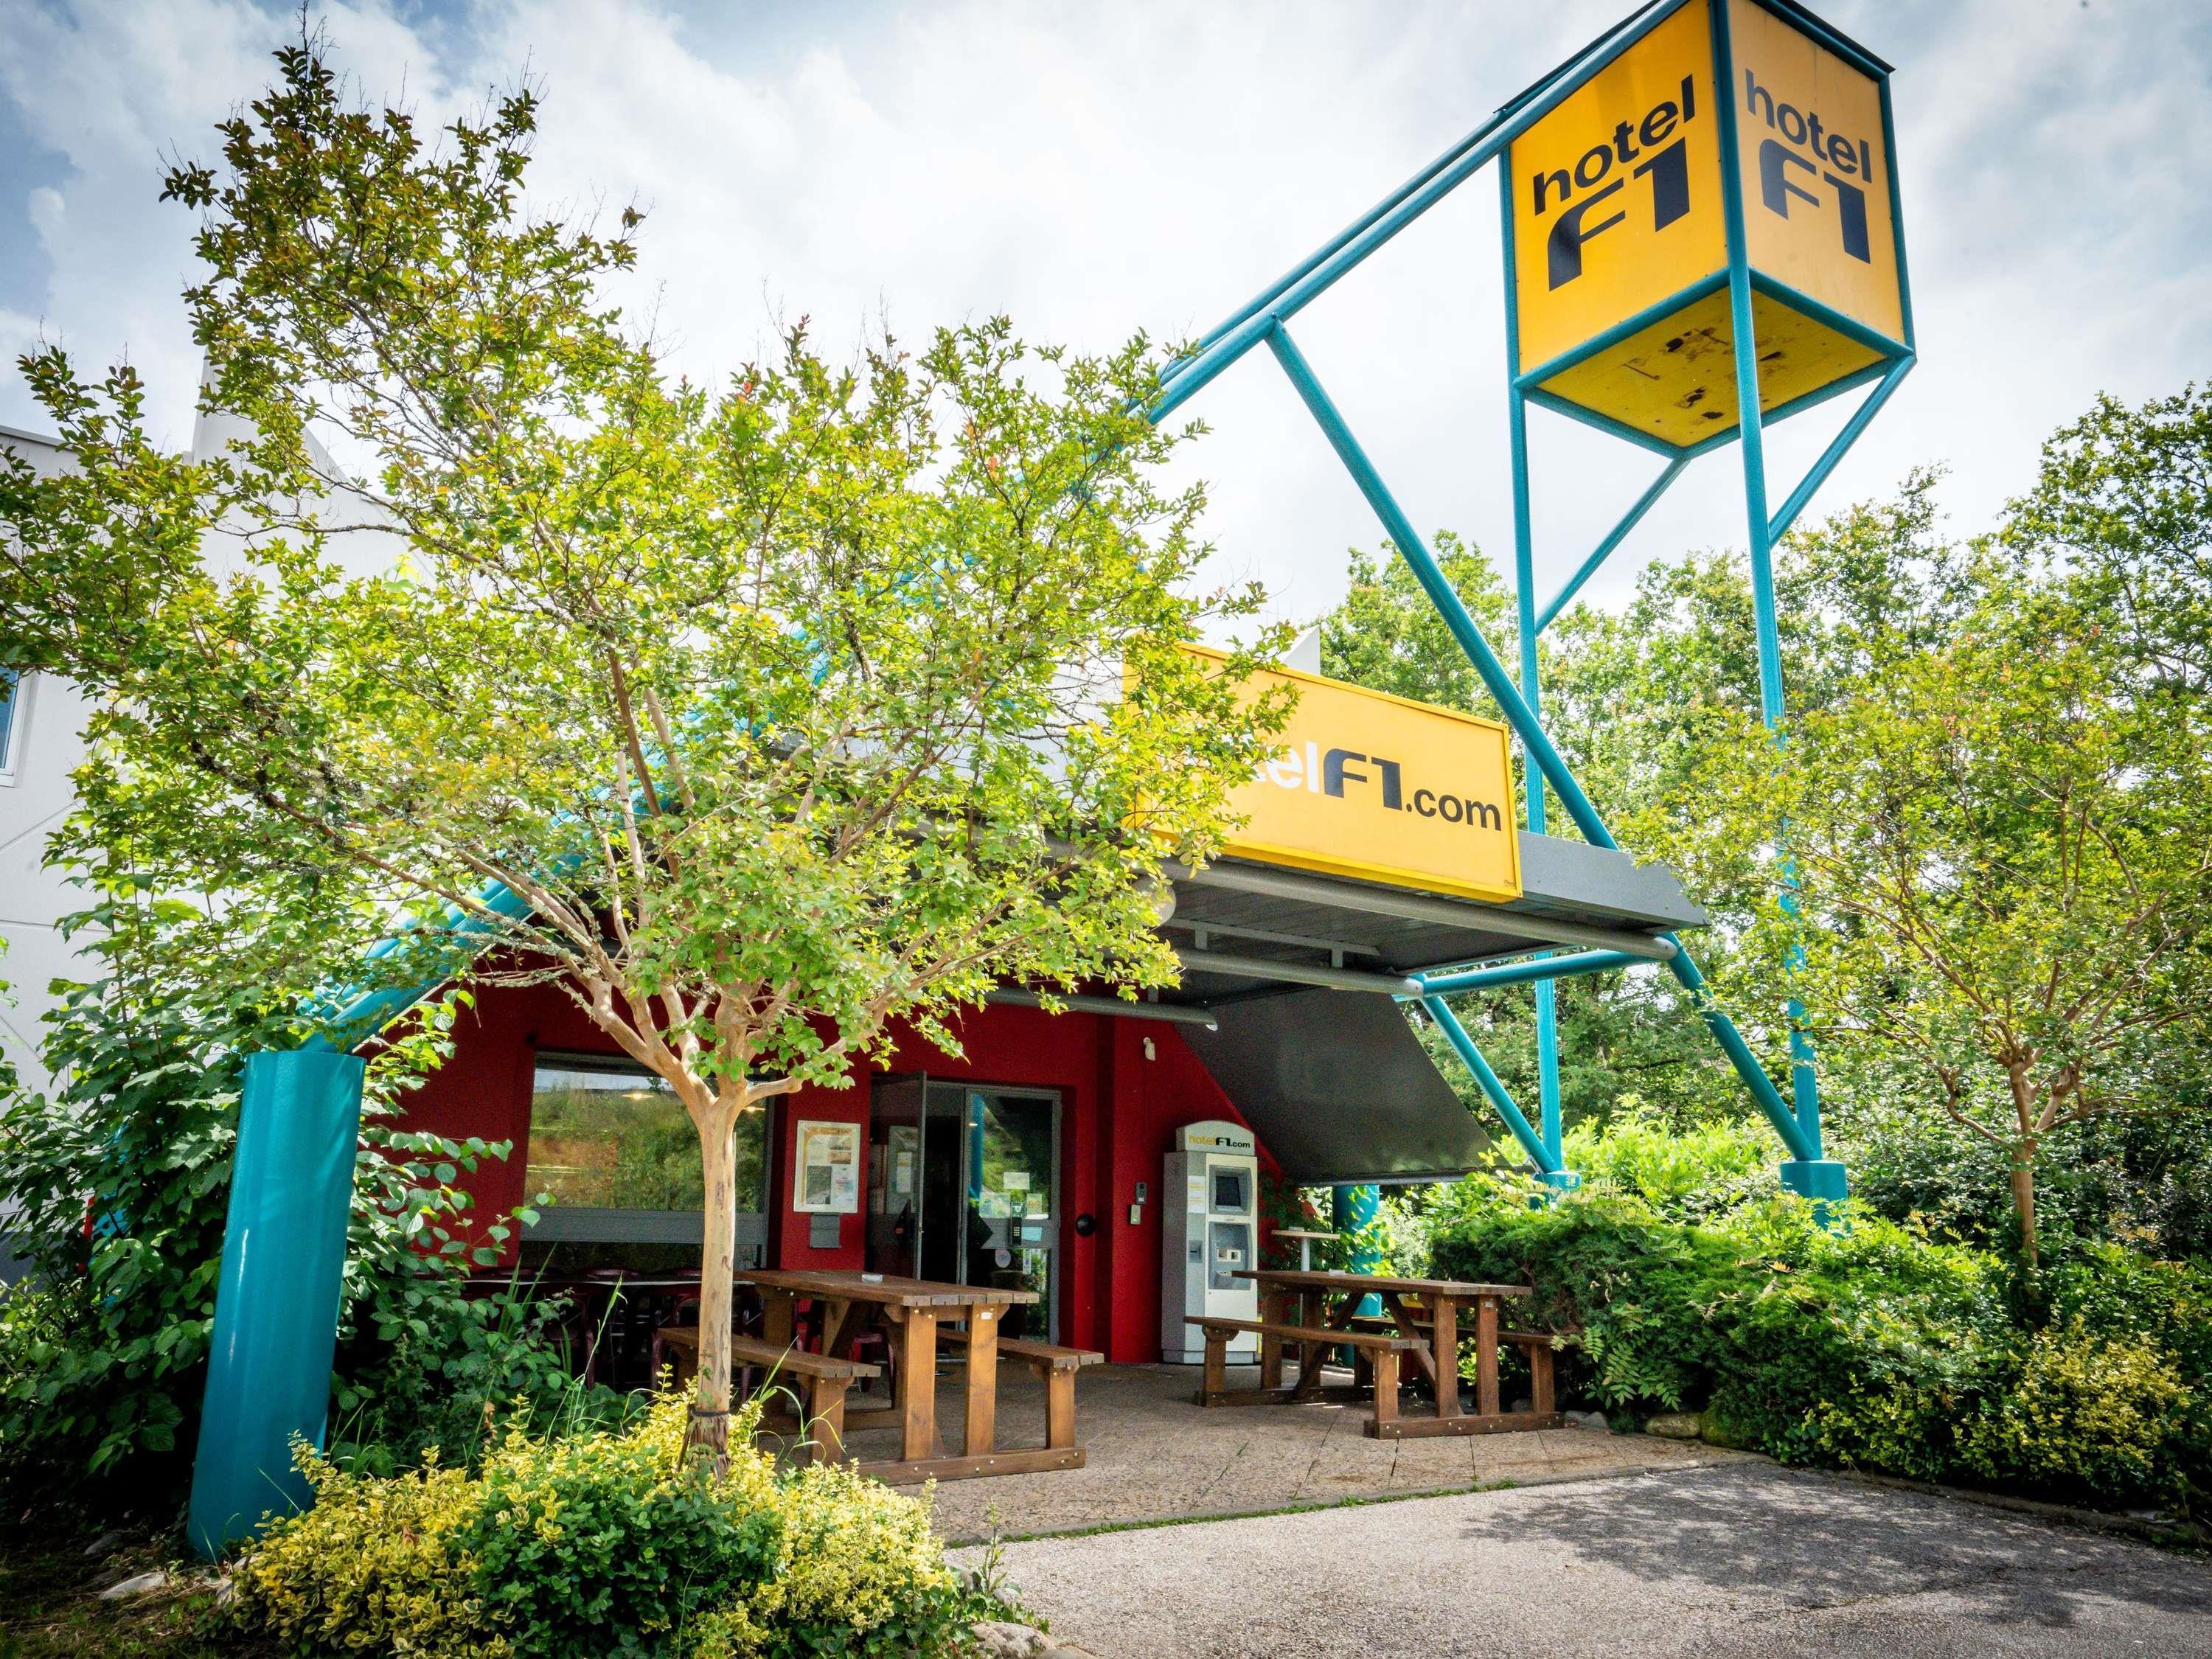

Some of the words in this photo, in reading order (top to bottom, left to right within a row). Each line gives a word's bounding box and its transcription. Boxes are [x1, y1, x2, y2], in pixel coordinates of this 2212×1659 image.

[1533, 73, 1696, 216] hotel
[1745, 67, 1872, 184] hotel
[1547, 136, 1691, 292] F1
[1759, 138, 1871, 265] F1
